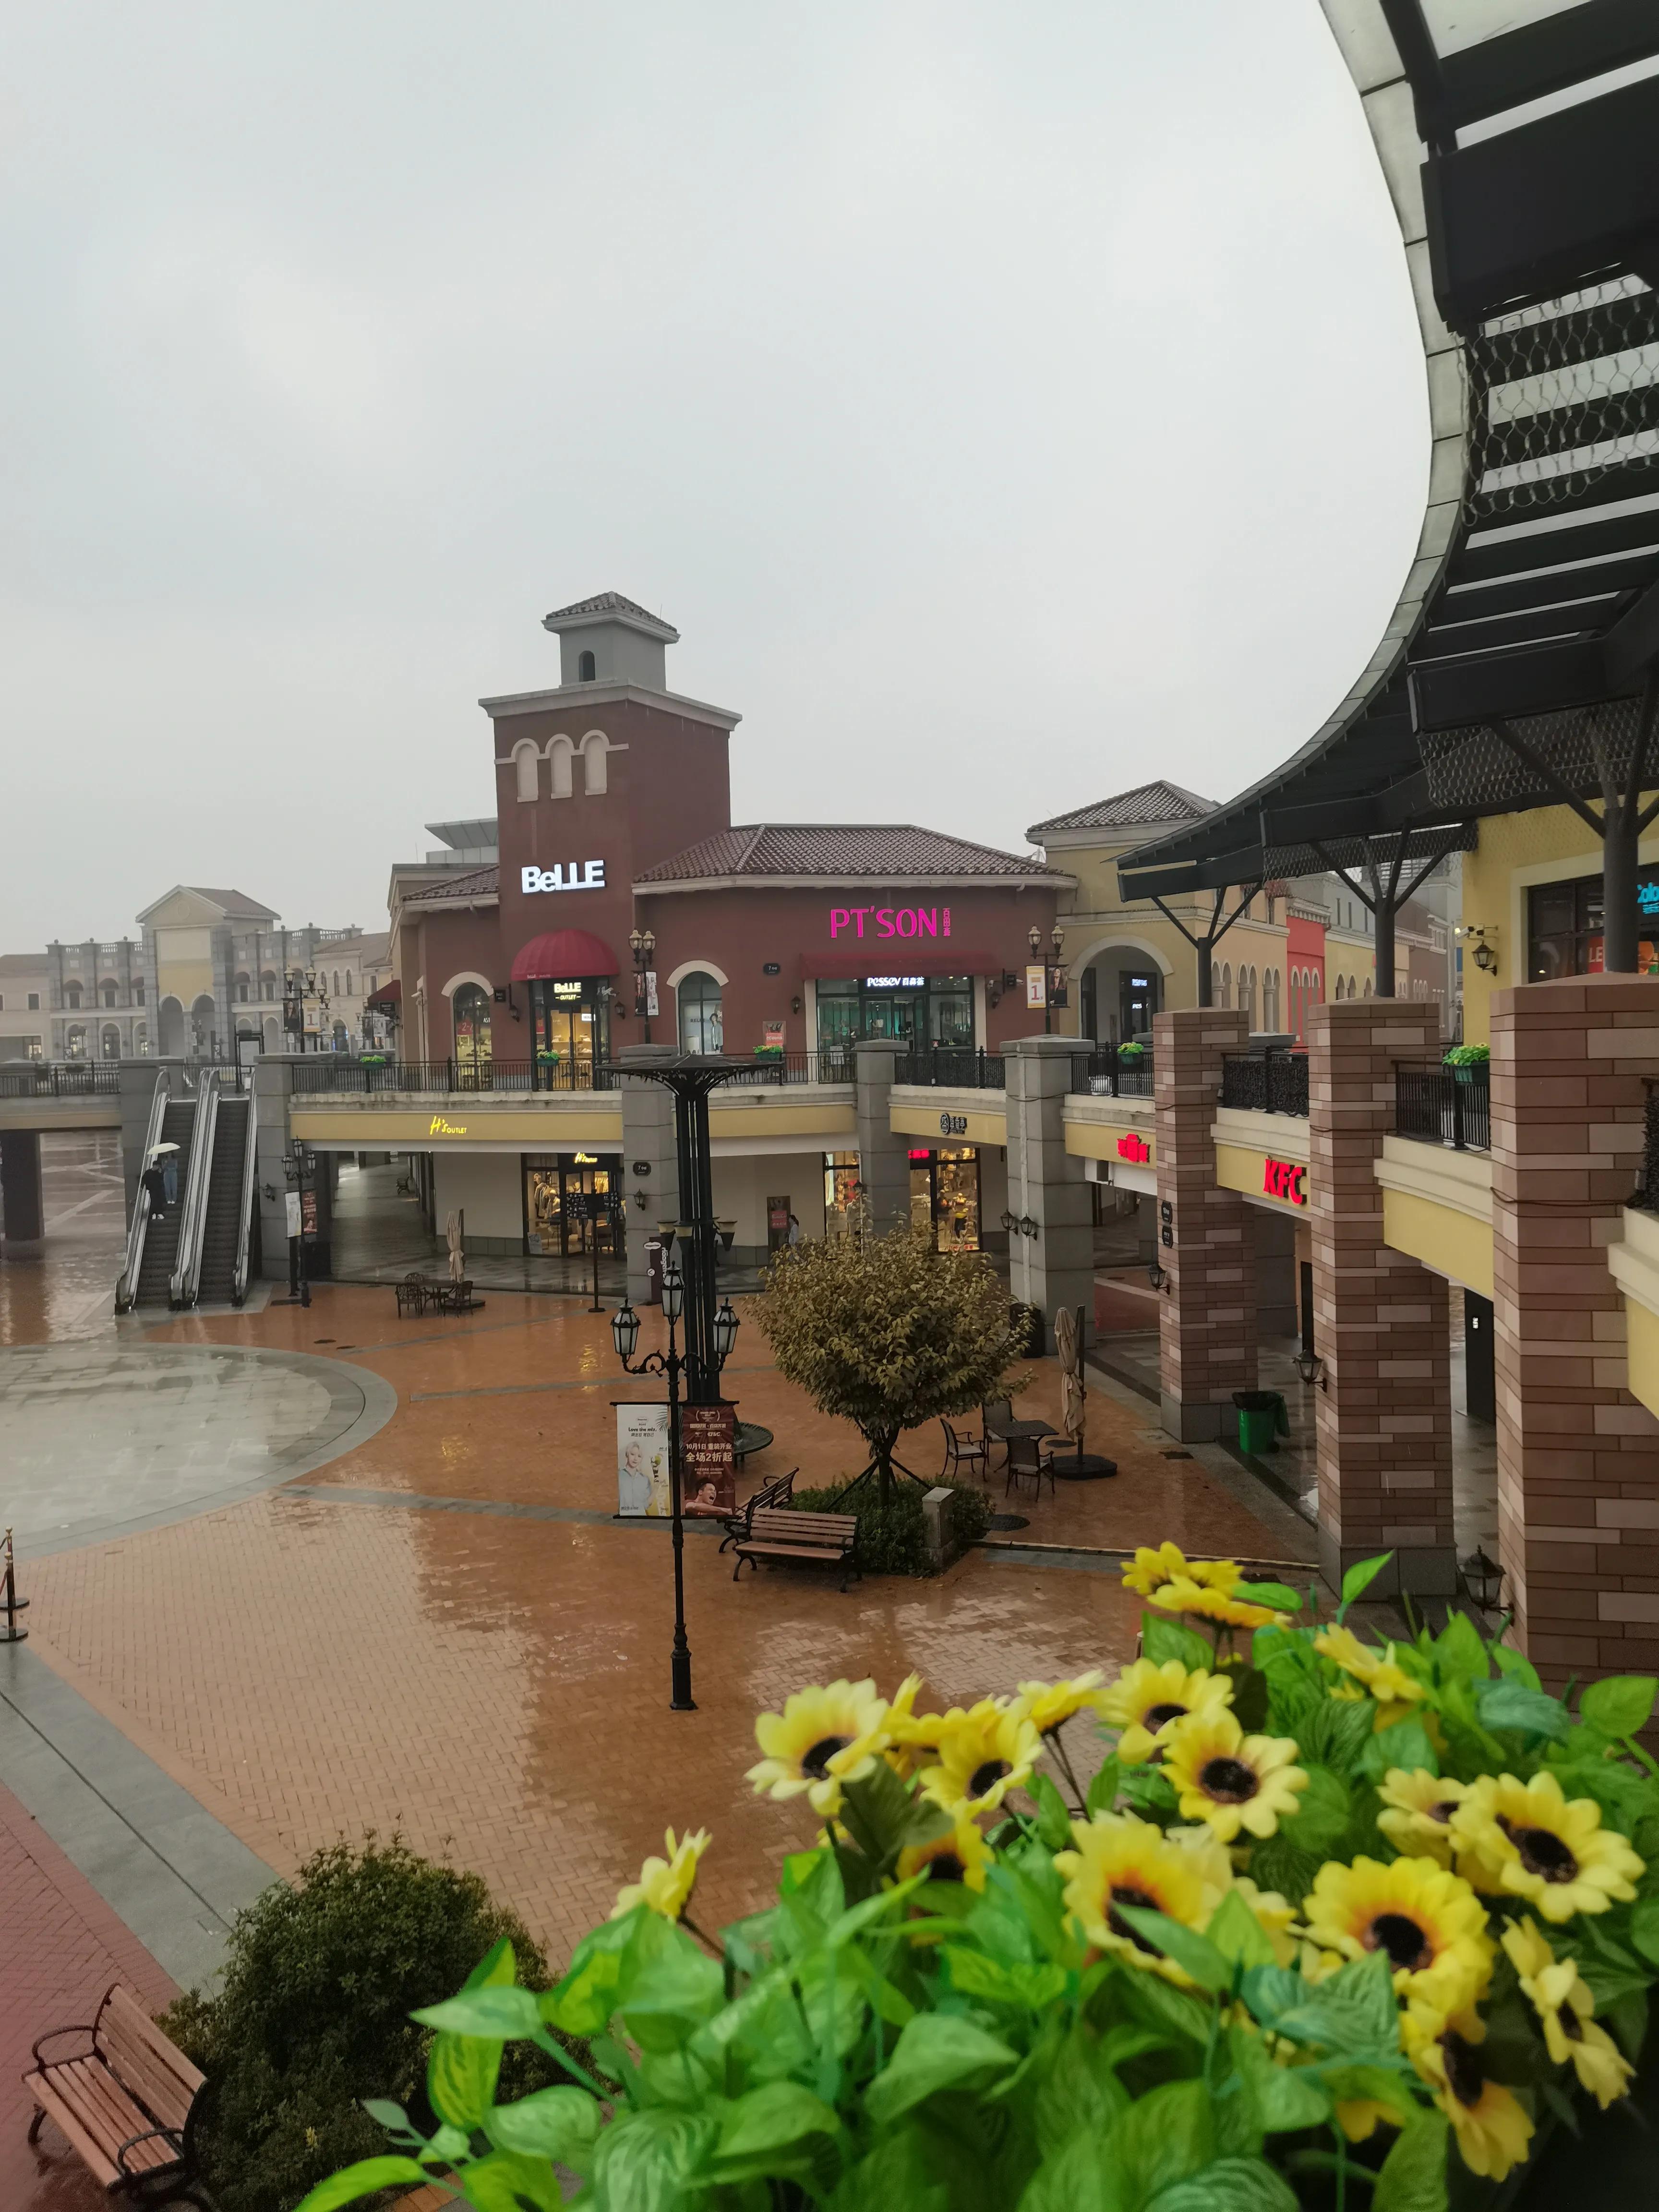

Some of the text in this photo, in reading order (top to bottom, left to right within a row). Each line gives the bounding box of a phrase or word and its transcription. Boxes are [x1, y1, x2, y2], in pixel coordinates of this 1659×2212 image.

[830, 905, 937, 938] PT'SON
[1263, 1158, 1303, 1204] KFC
[685, 1451, 733, 1462] 全场2折起
